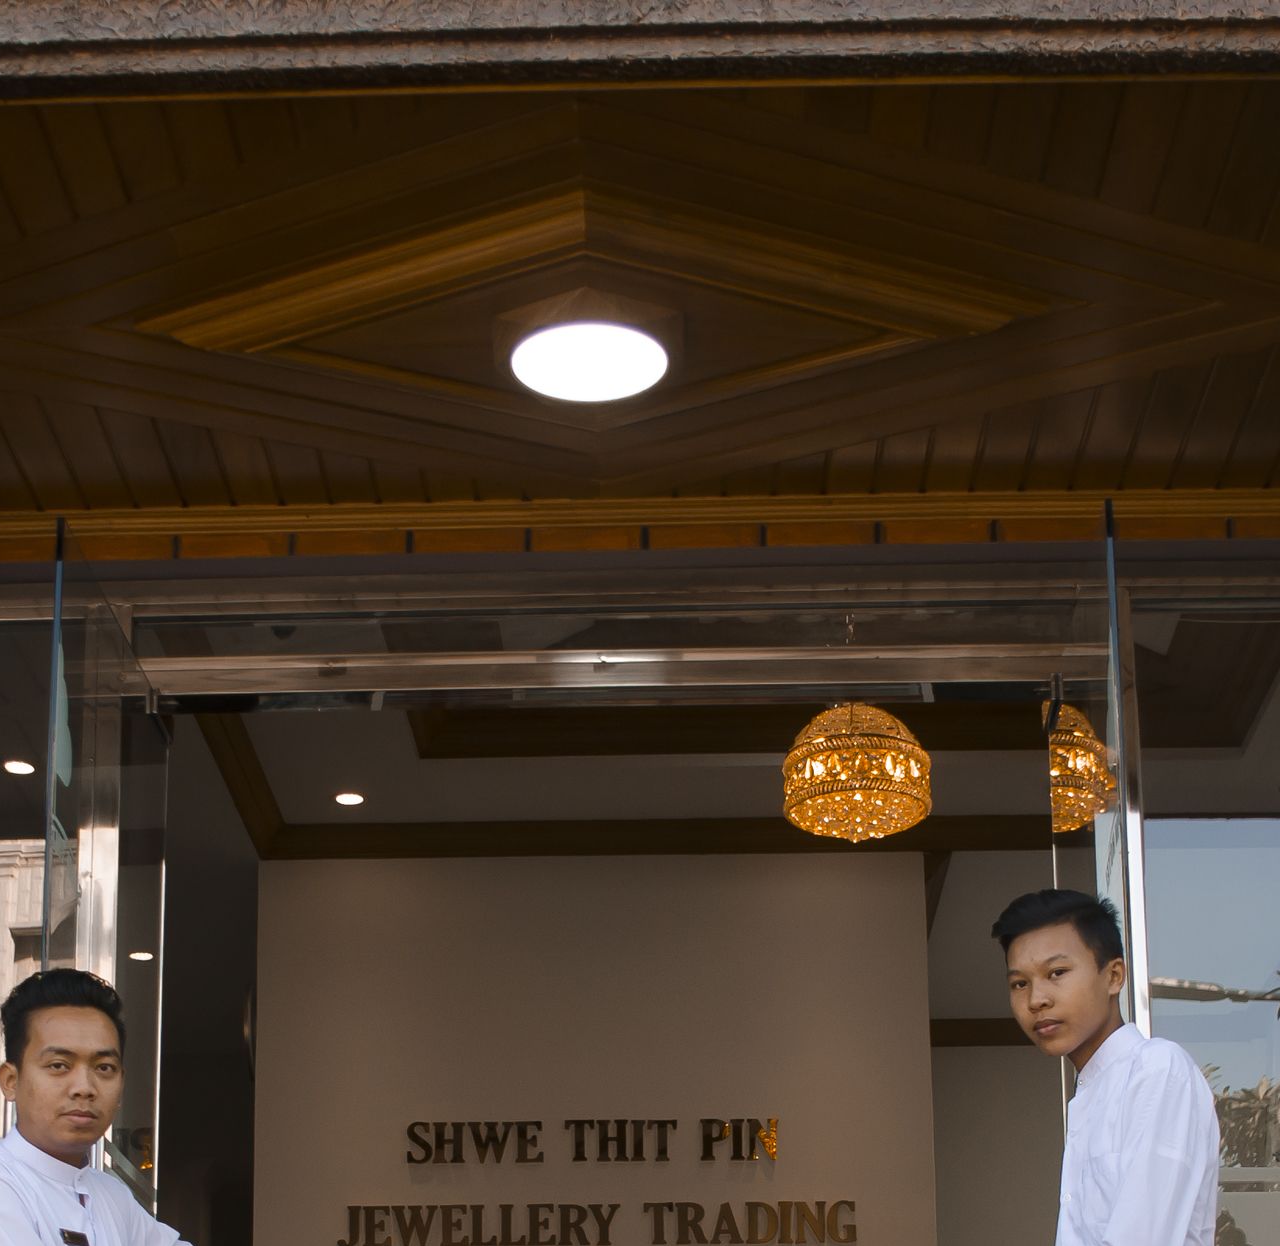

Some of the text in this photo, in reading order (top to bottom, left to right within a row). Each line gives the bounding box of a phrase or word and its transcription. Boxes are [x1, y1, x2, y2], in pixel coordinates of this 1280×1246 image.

[406, 1117, 779, 1164] SHWE THIT PIN
[643, 1200, 858, 1246] TRADING
